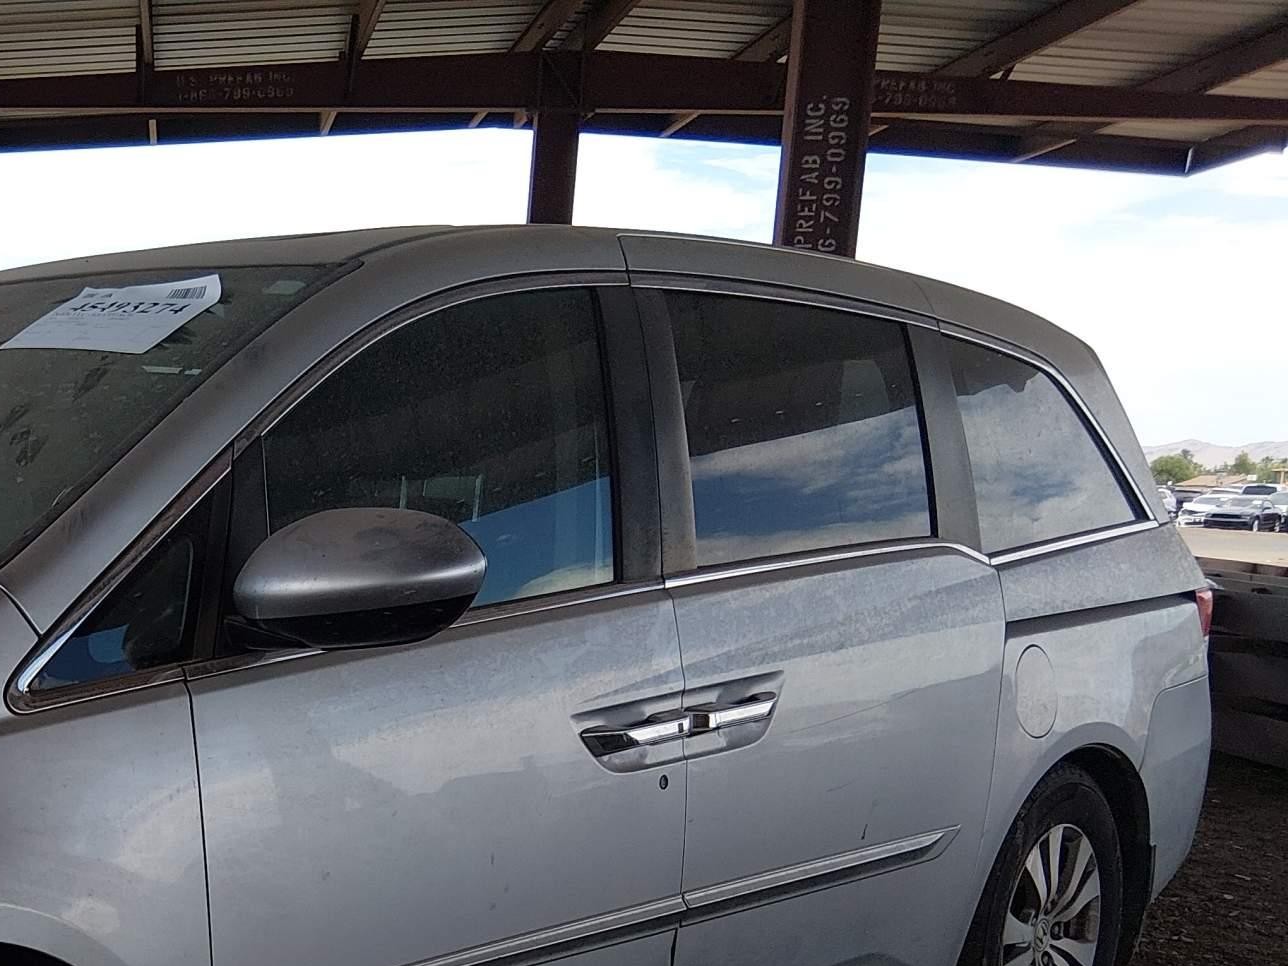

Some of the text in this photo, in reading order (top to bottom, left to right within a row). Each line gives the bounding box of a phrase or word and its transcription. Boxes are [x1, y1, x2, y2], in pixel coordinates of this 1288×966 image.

[793, 95, 827, 249] PREFAB INC.
[69, 300, 192, 315] 45493274
